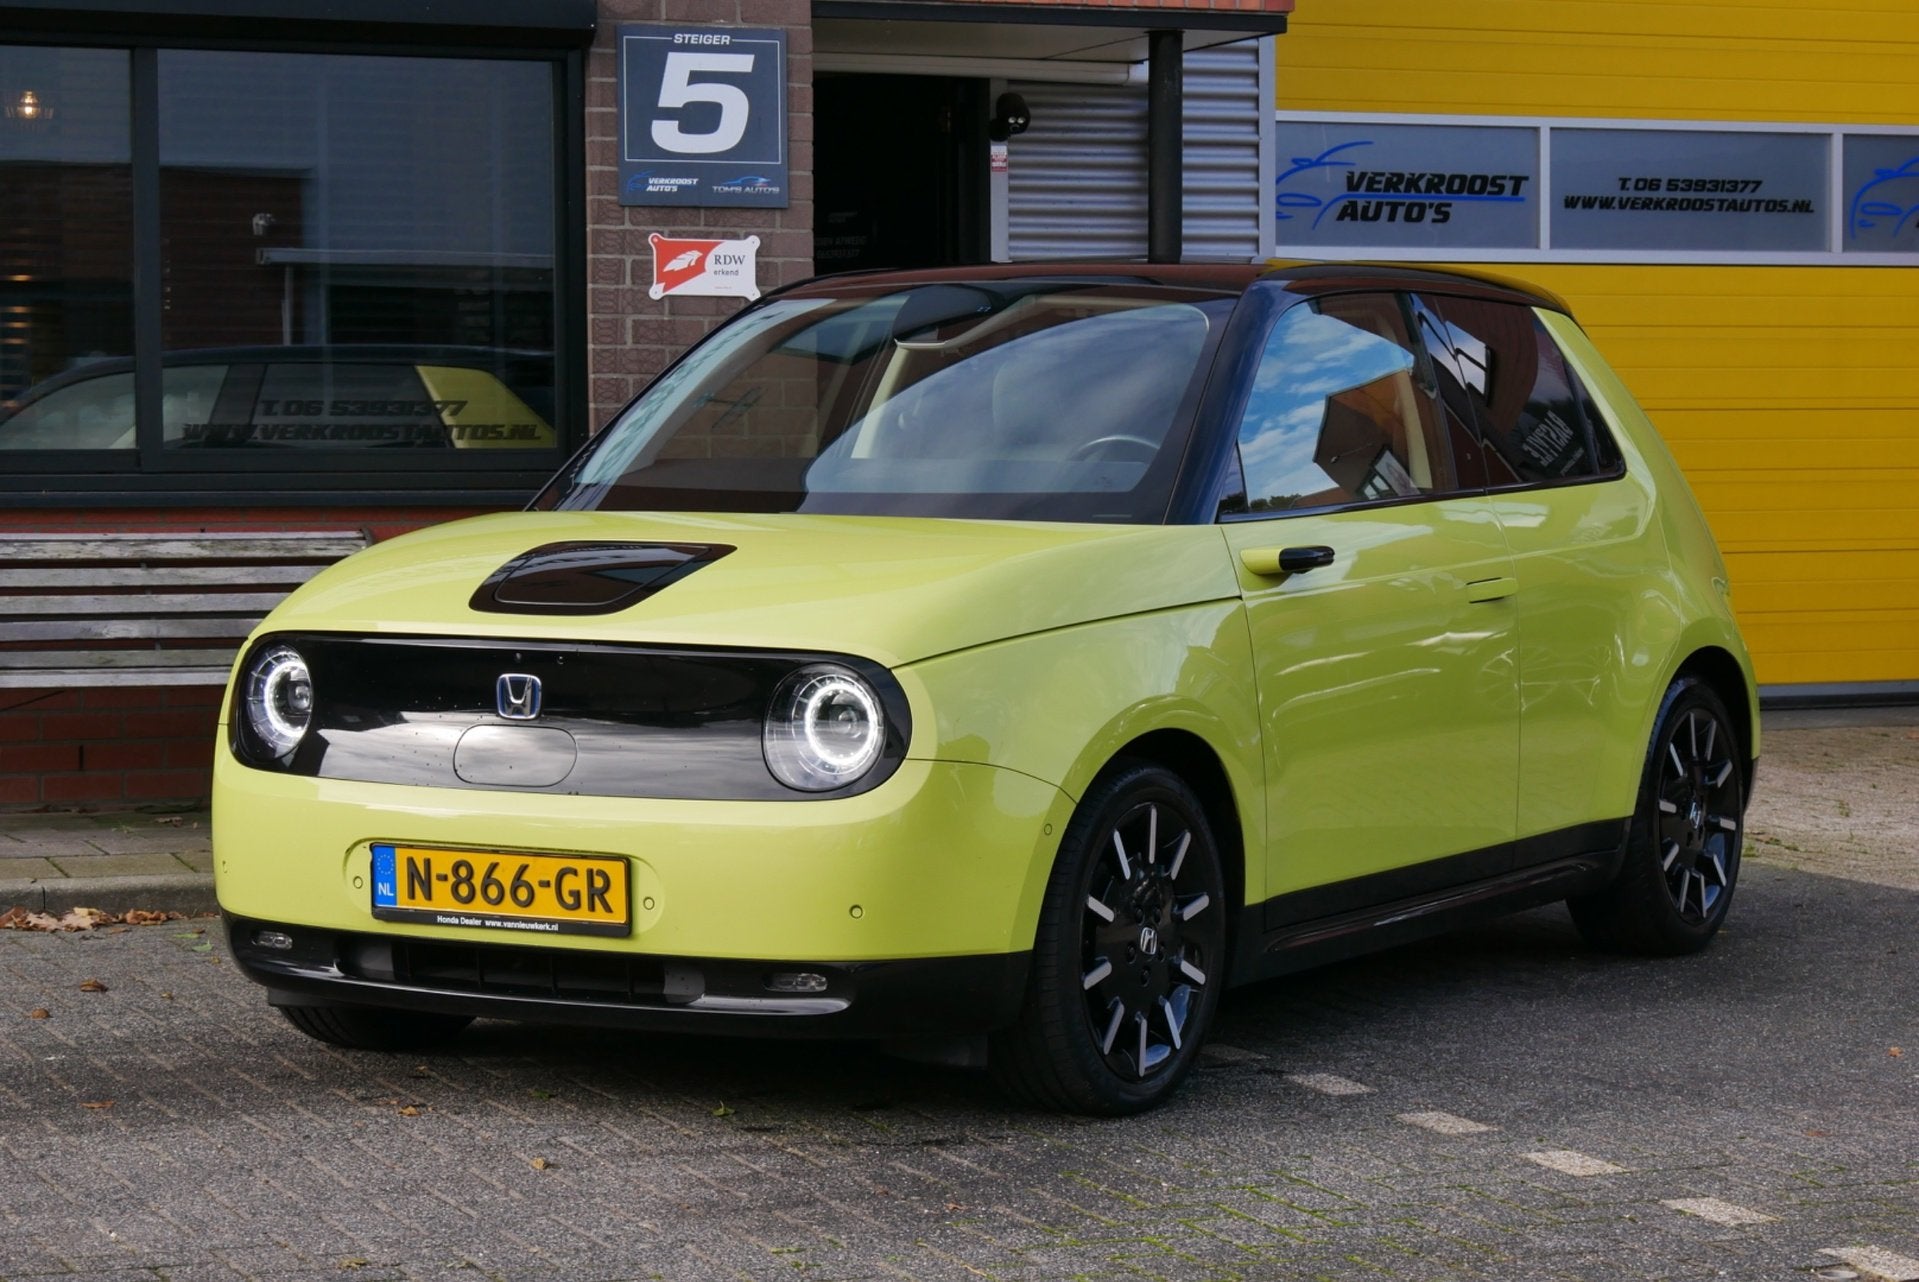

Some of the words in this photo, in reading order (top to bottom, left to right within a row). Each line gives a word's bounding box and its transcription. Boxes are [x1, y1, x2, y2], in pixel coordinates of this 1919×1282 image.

[673, 33, 731, 46] STEIGER
[651, 52, 755, 153] 5
[646, 184, 678, 193] AUTO'S
[648, 177, 699, 186] VERKROOST
[1346, 171, 1529, 196] VERKROOST
[1634, 178, 1661, 192] 06
[1666, 179, 1764, 193] 53931377
[1336, 200, 1452, 223] AUTO'S
[1564, 195, 1815, 213] WWW.VERKROOSTAUTOS.NL
[714, 253, 746, 267] RDW
[713, 267, 739, 277] erkend
[282, 400, 322, 416] 06
[329, 401, 469, 416] 53931377
[378, 882, 394, 896] NL
[406, 856, 613, 913] N-866-GR
[437, 915, 459, 925] Honda
[461, 917, 482, 926] Dealer
[485, 919, 559, 931] www.vannieuwkerk.nl
